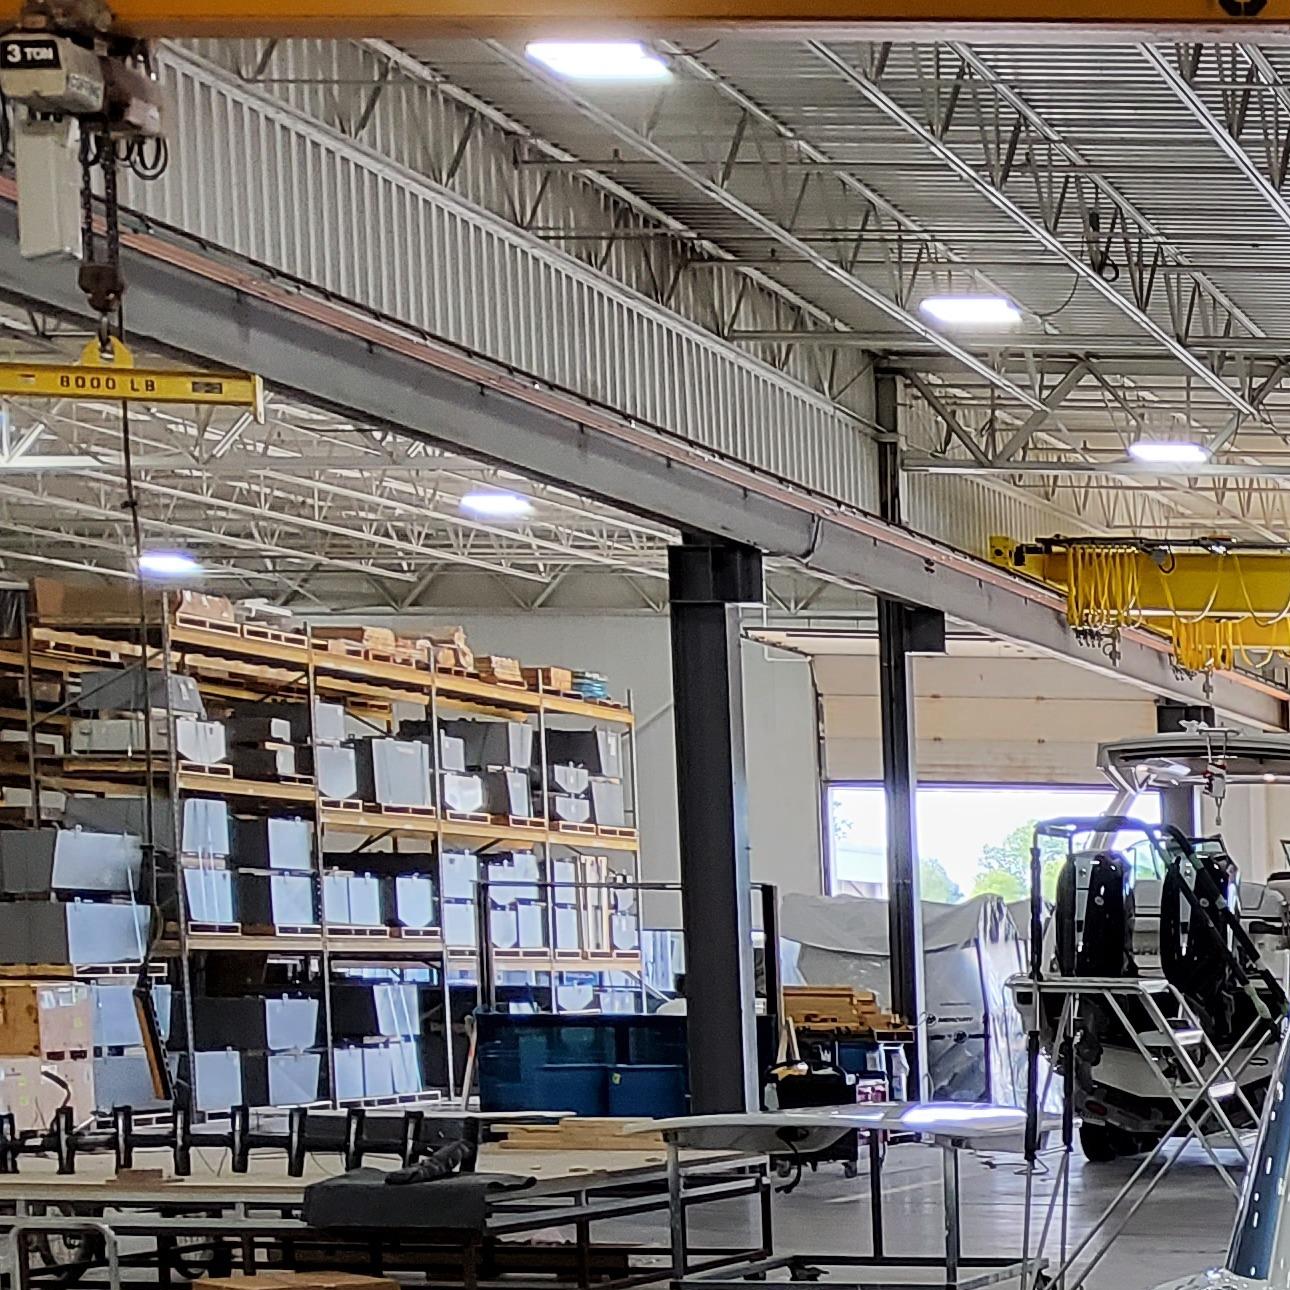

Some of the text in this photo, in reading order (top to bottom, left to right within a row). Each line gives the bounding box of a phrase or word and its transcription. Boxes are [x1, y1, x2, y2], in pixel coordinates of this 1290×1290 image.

[7, 43, 54, 63] 3 TON
[60, 375, 156, 392] 8000 LB
